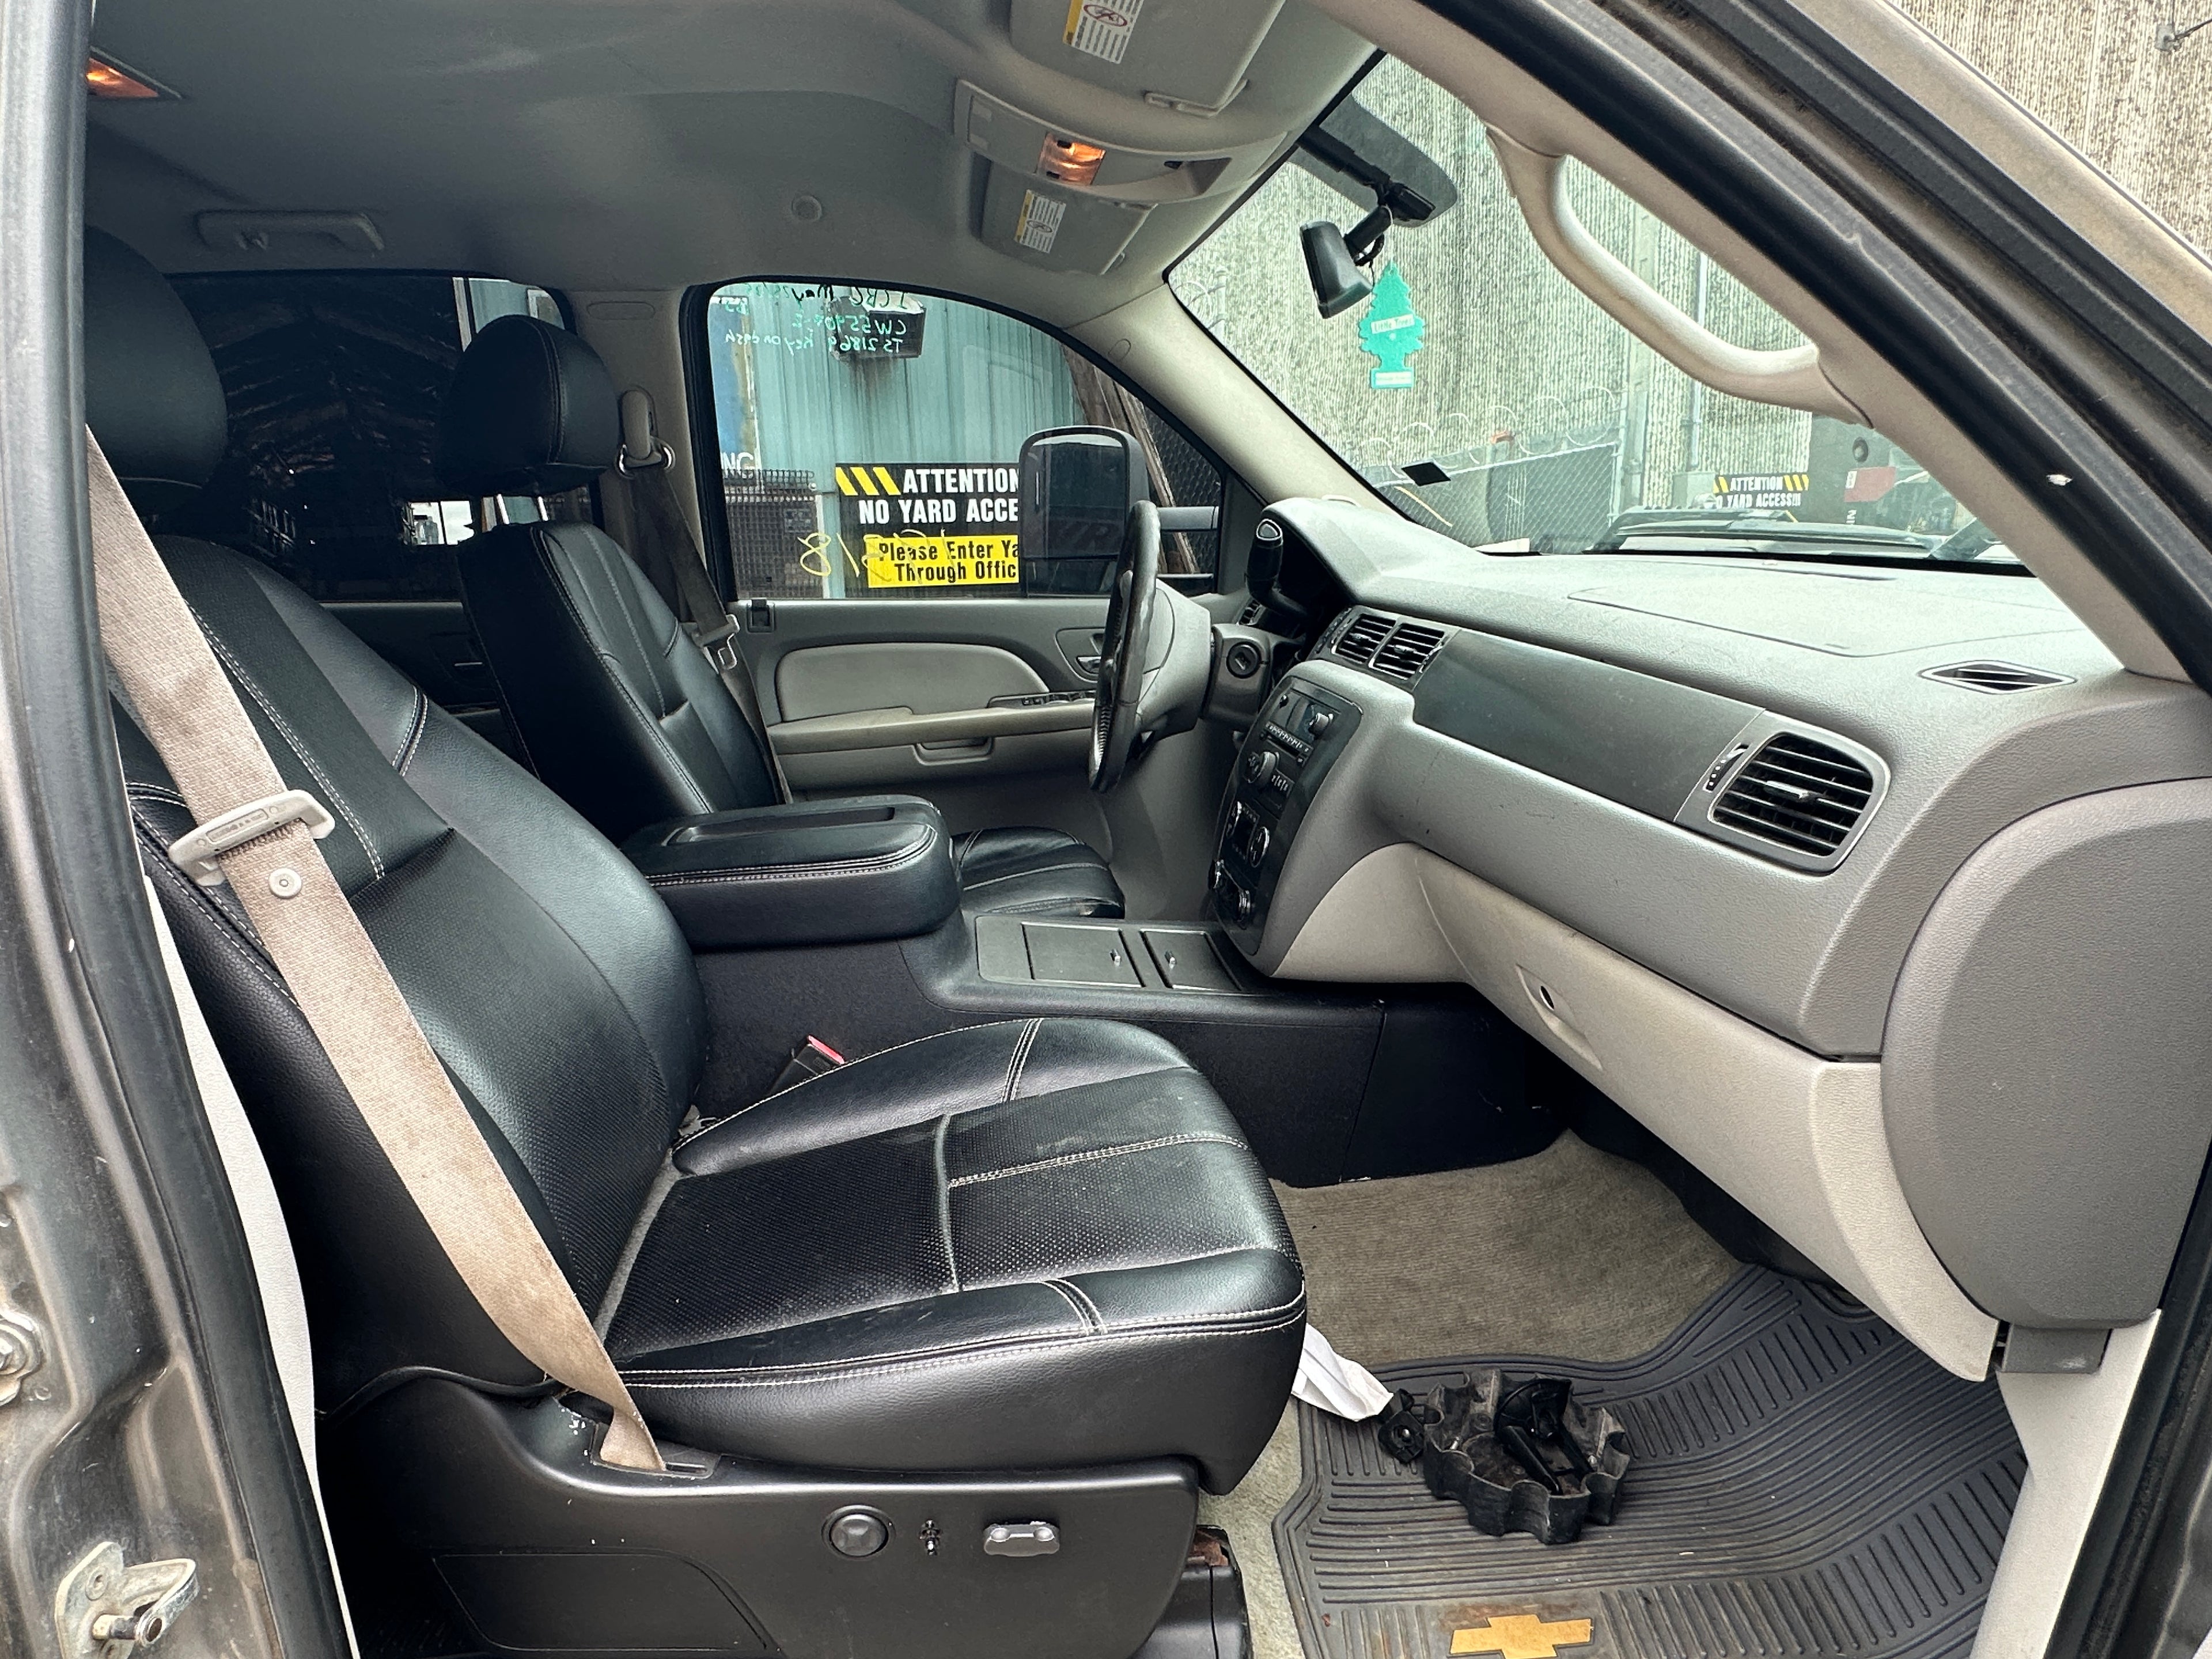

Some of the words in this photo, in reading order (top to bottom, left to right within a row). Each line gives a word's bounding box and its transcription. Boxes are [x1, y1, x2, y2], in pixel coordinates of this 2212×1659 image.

[903, 468, 1018, 493] ATTENTION
[1730, 476, 1783, 491] ATTENTION
[858, 499, 890, 524] NO
[898, 499, 957, 524] YARD
[1727, 494, 1752, 509] YARD
[879, 543, 938, 562] Please
[947, 541, 994, 559] Enter
[894, 562, 967, 583] Through
